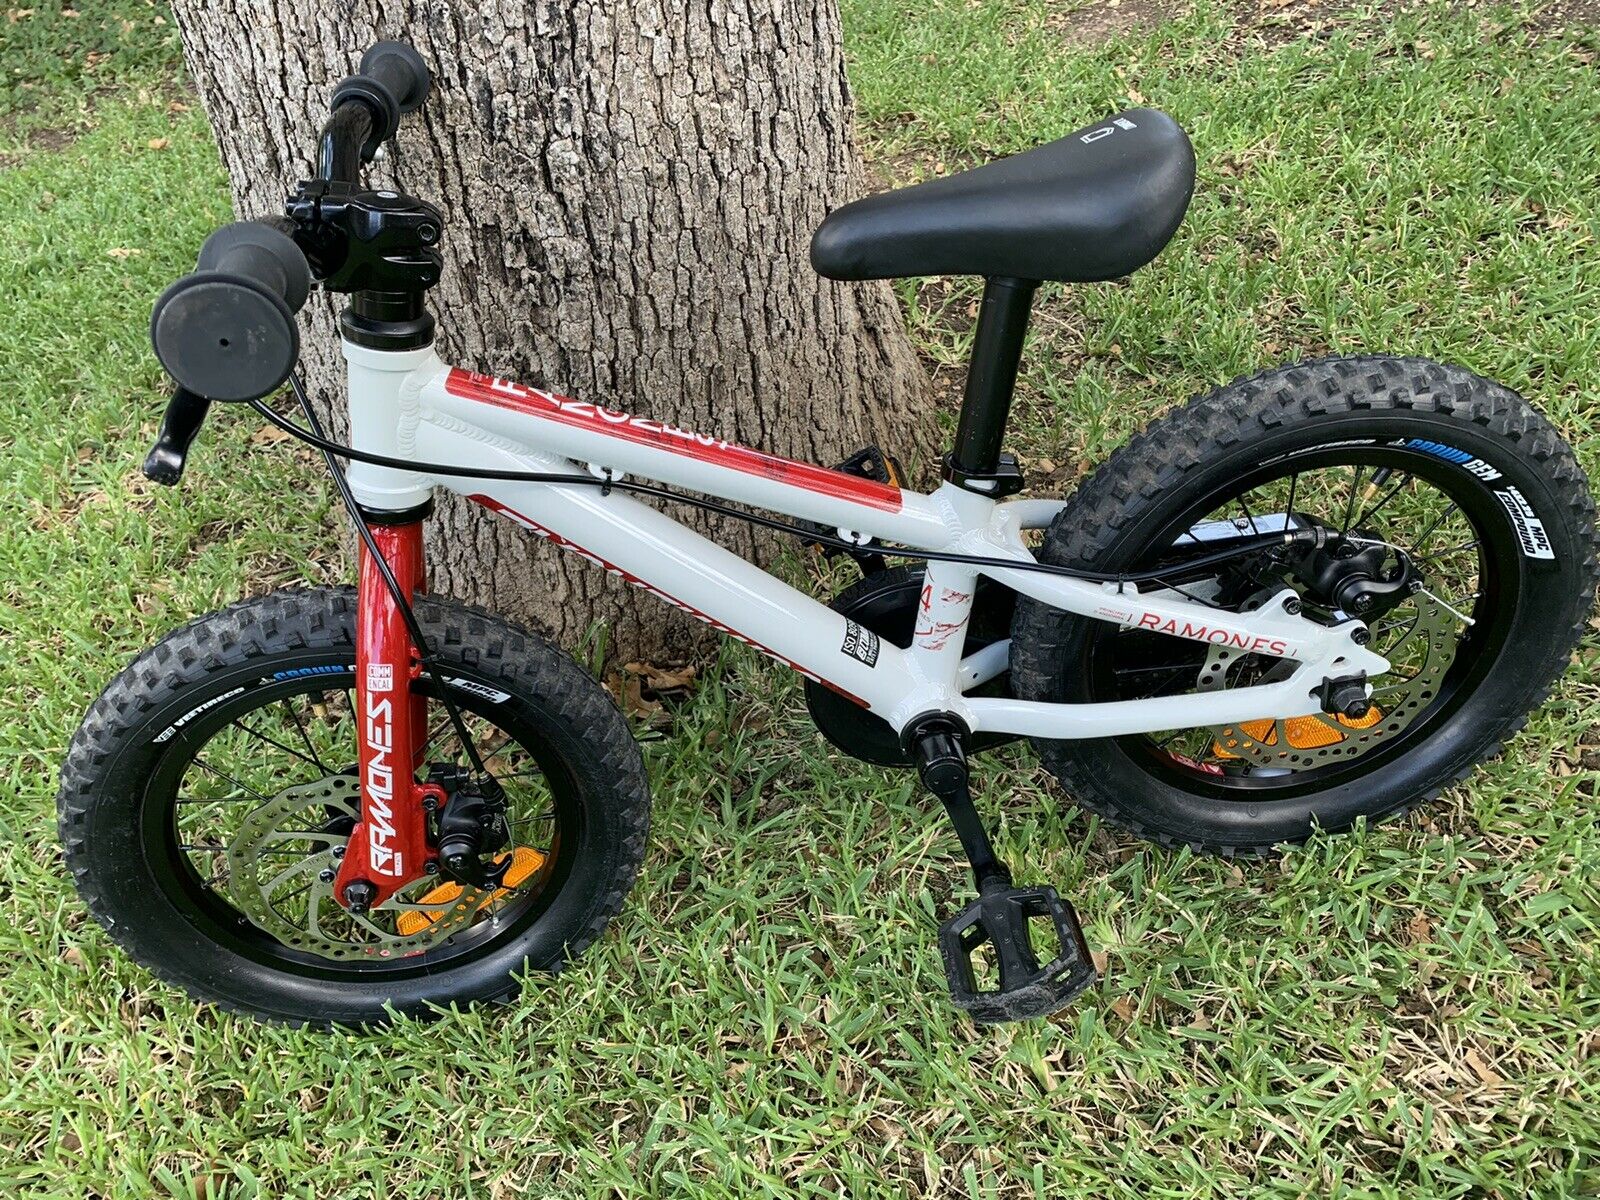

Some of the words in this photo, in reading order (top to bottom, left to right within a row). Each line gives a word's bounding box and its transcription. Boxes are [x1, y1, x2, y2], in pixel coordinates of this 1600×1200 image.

[1462, 459, 1502, 481] GEM
[1500, 493, 1537, 554] COMPOUND
[1530, 525, 1549, 552] MPC
[843, 637, 856, 654] ISO
[1137, 612, 1288, 657] RAMONES
[368, 679, 391, 690] ENCAL
[461, 681, 500, 697] MPC
[366, 691, 397, 877] RAMONES
